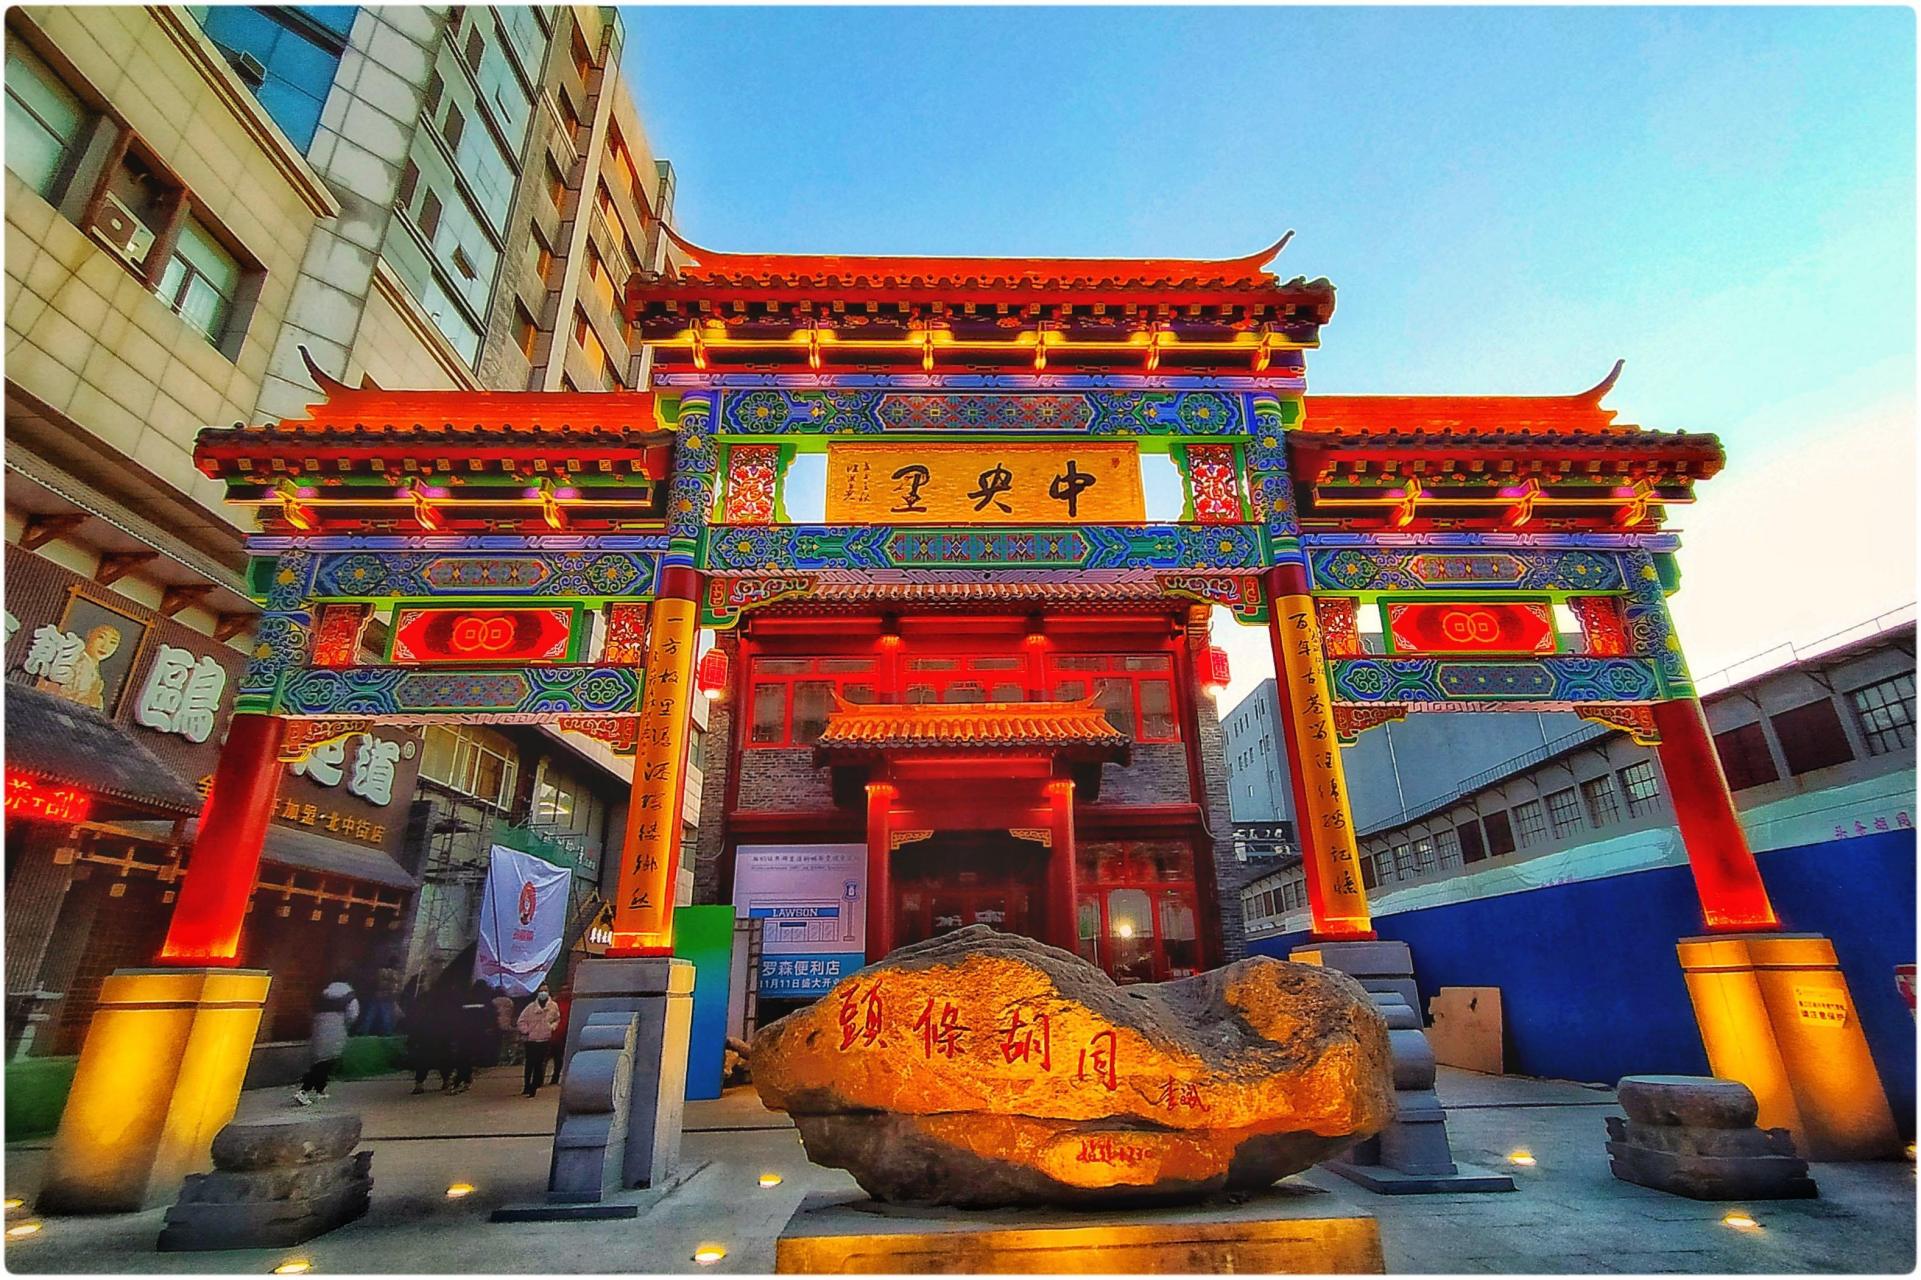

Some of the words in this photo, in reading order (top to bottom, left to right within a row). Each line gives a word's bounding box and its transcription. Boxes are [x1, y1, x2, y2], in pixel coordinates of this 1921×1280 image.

[772, 908, 818, 918] LAWSON
[762, 960, 841, 977] 罗森便利店
